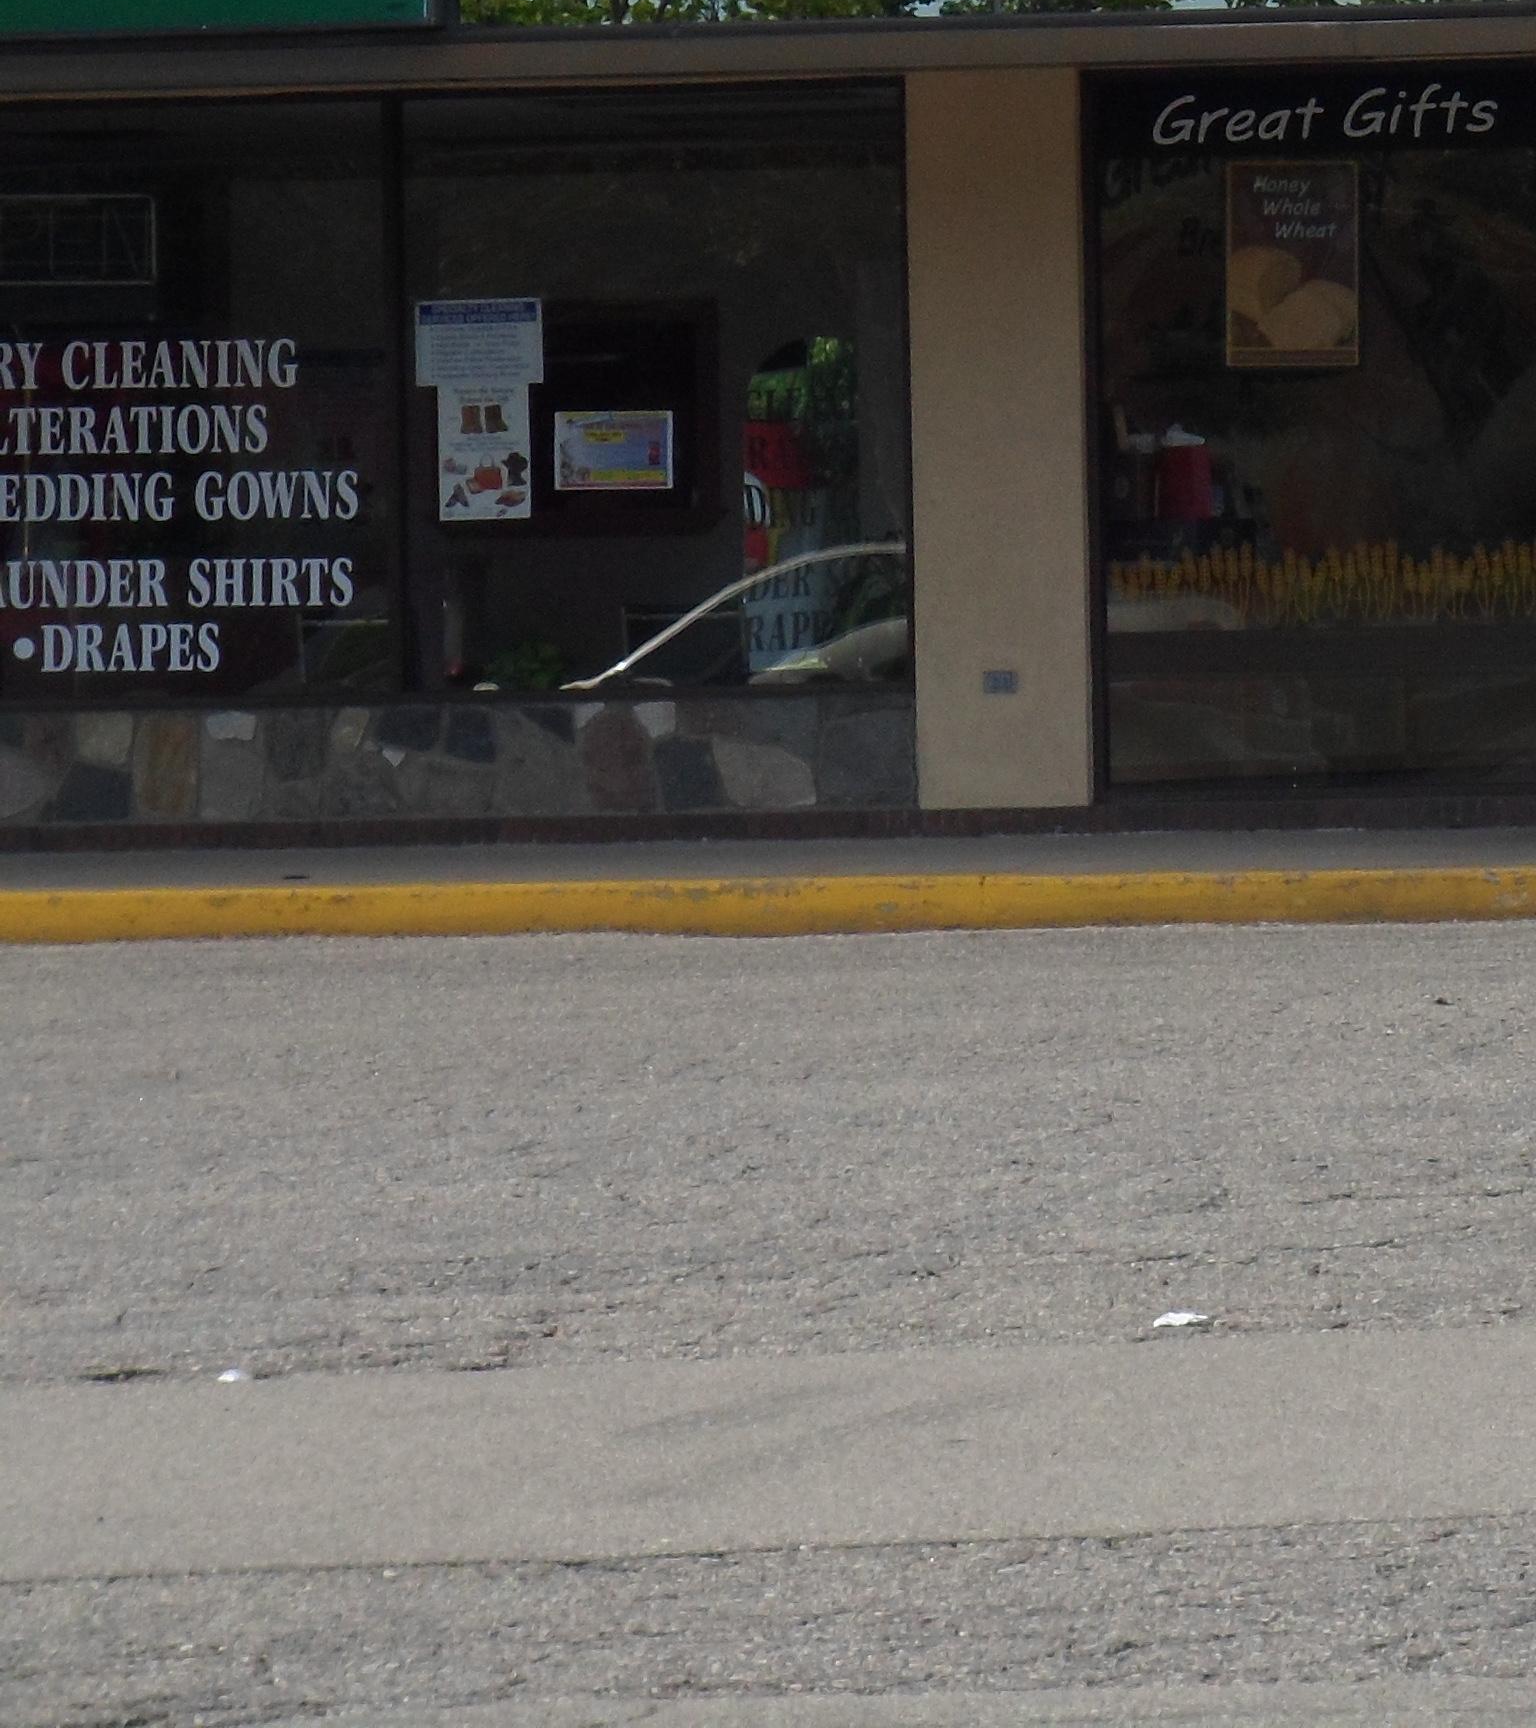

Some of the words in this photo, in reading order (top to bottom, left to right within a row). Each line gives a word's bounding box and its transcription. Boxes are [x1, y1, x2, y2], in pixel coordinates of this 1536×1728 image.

[1152, 95, 1325, 145] Great
[1343, 83, 1499, 138] Gifts
[1253, 175, 1311, 194] Honey
[1264, 198, 1321, 216] Whole
[1275, 221, 1338, 239] Wheat
[61, 338, 299, 390] CLEANING
[0, 404, 269, 456] TERATIONS
[0, 470, 175, 522] EDDING
[194, 469, 360, 521] GOWNS
[0, 558, 168, 609] UNDER
[187, 557, 354, 608] SHIRTS
